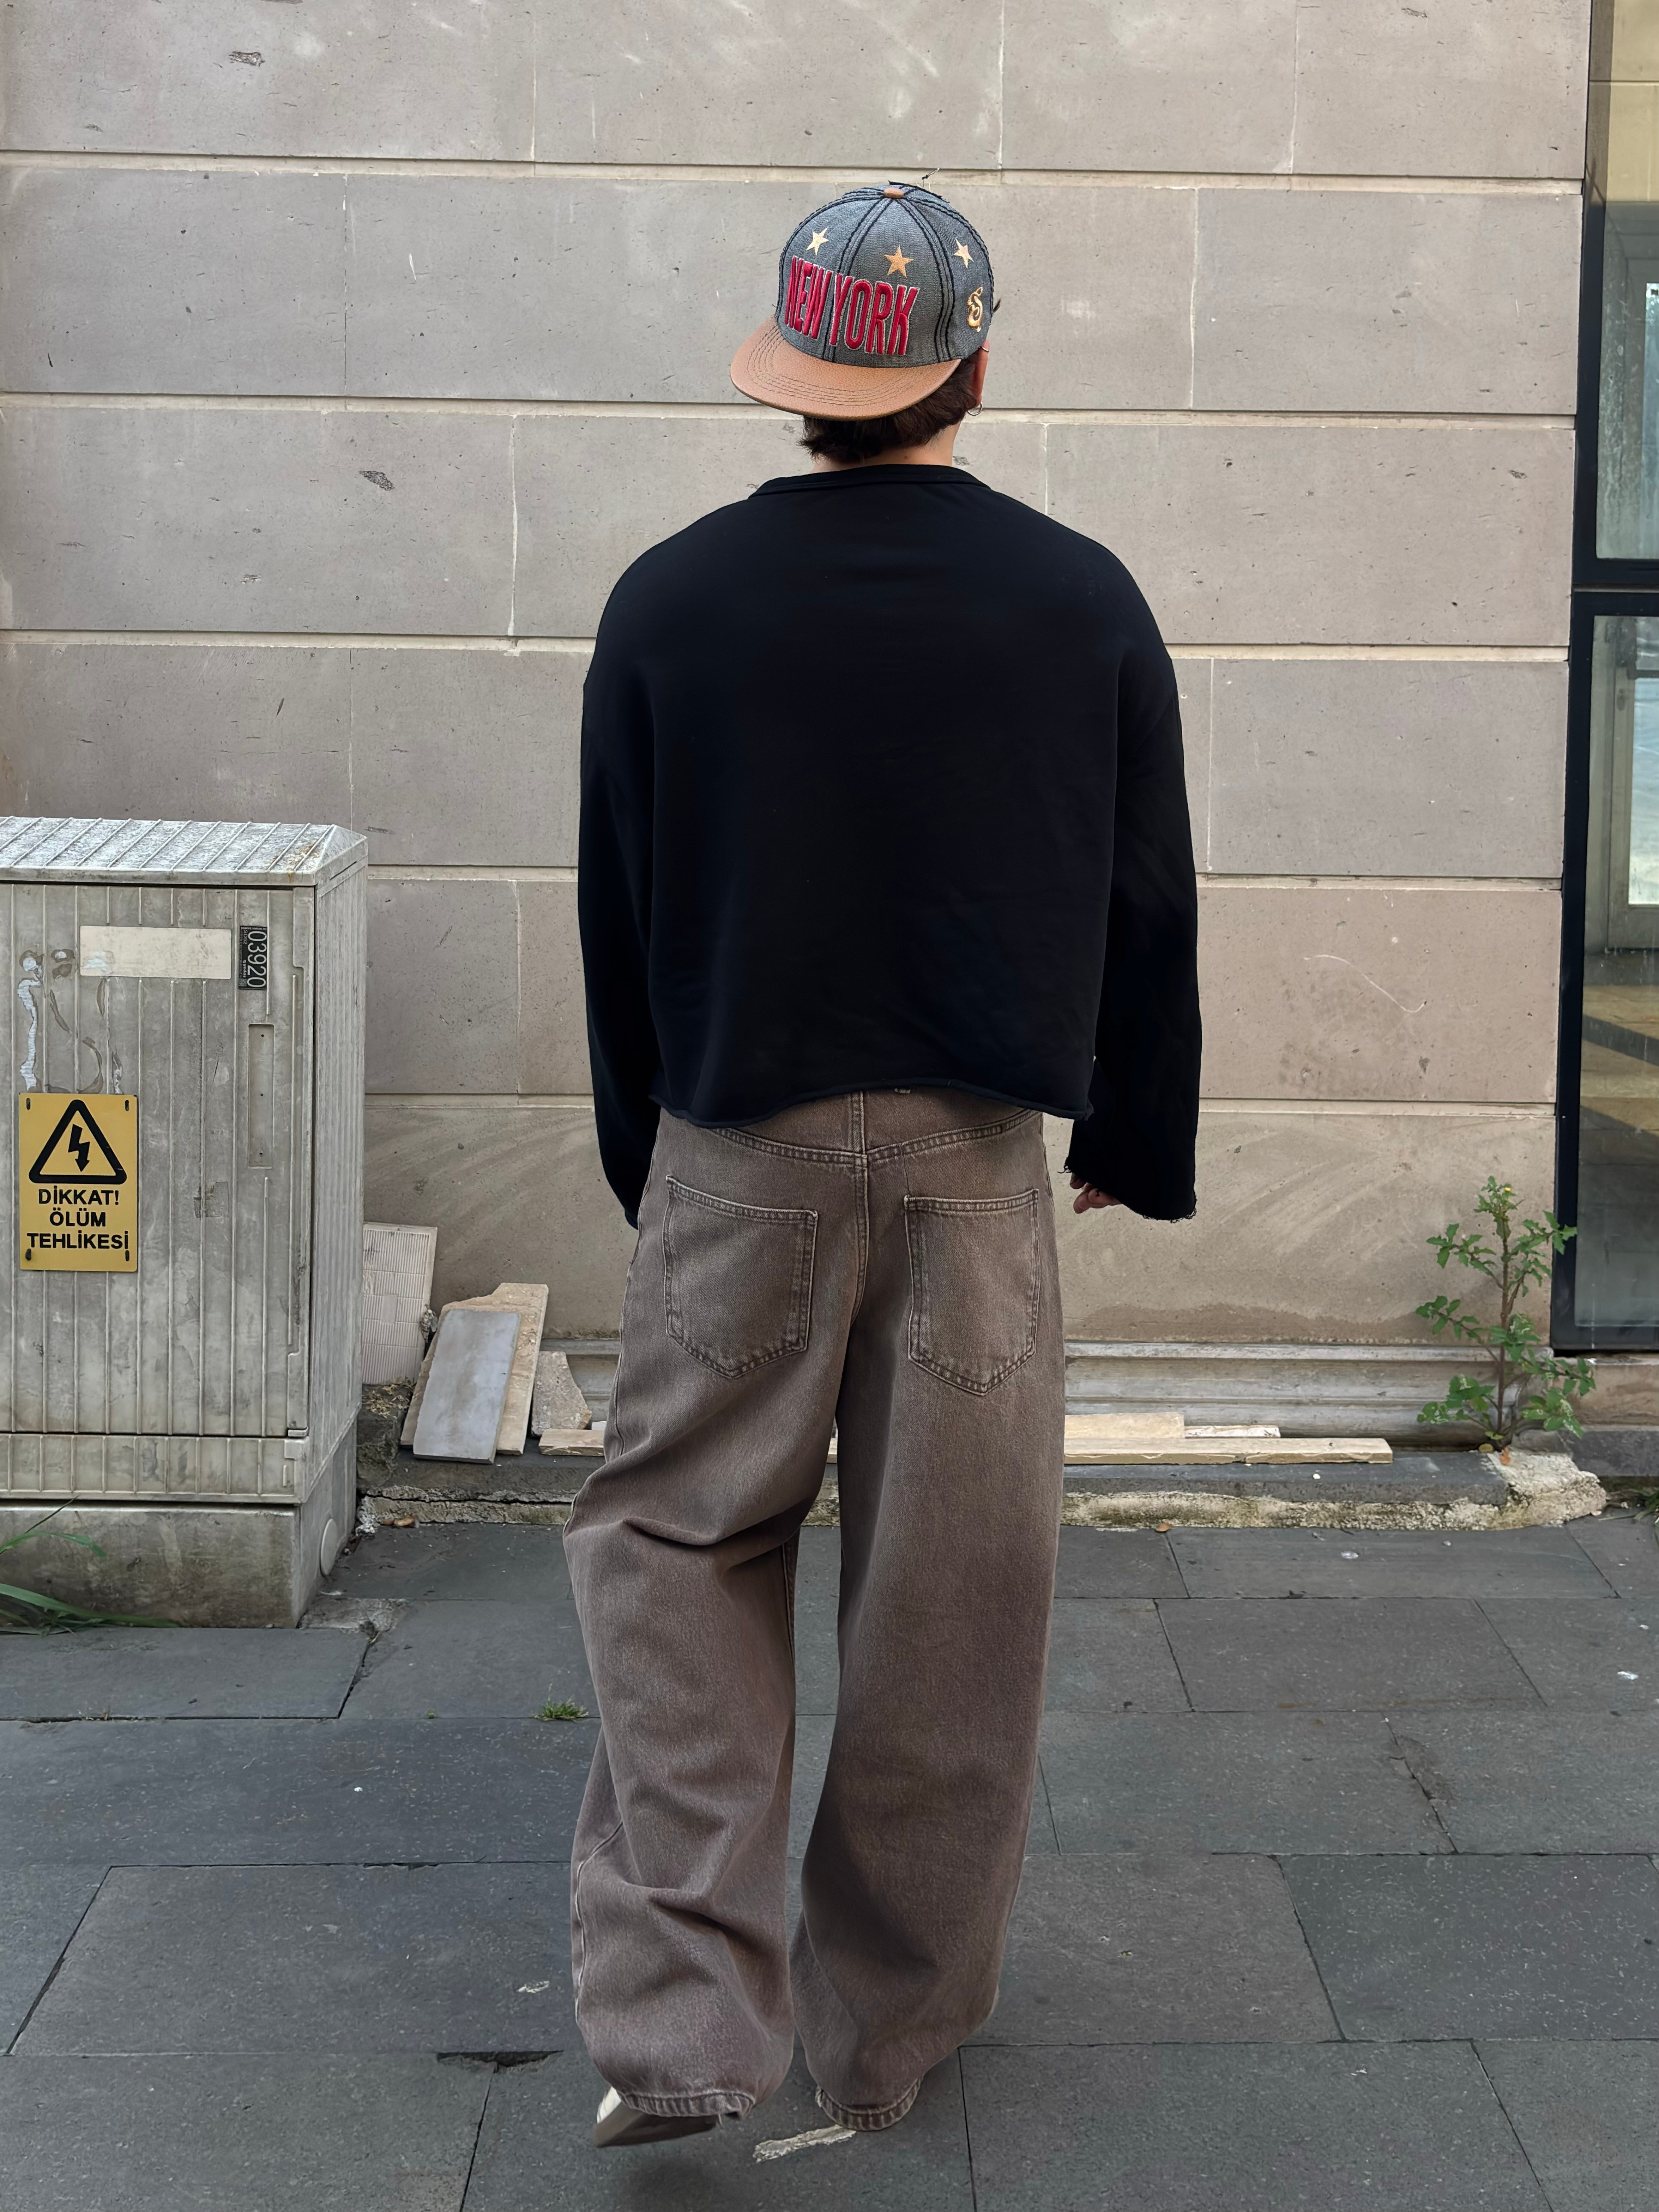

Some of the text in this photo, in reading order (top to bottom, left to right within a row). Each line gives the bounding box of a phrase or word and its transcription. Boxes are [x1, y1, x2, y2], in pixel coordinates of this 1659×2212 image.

[784, 255, 920, 355] NEW YORK
[247, 931, 267, 988] 03920
[38, 1185, 119, 1205] DİKKAT!
[49, 1207, 106, 1227] ÖLÜM
[26, 1230, 129, 1249] TEHLİKESİ
